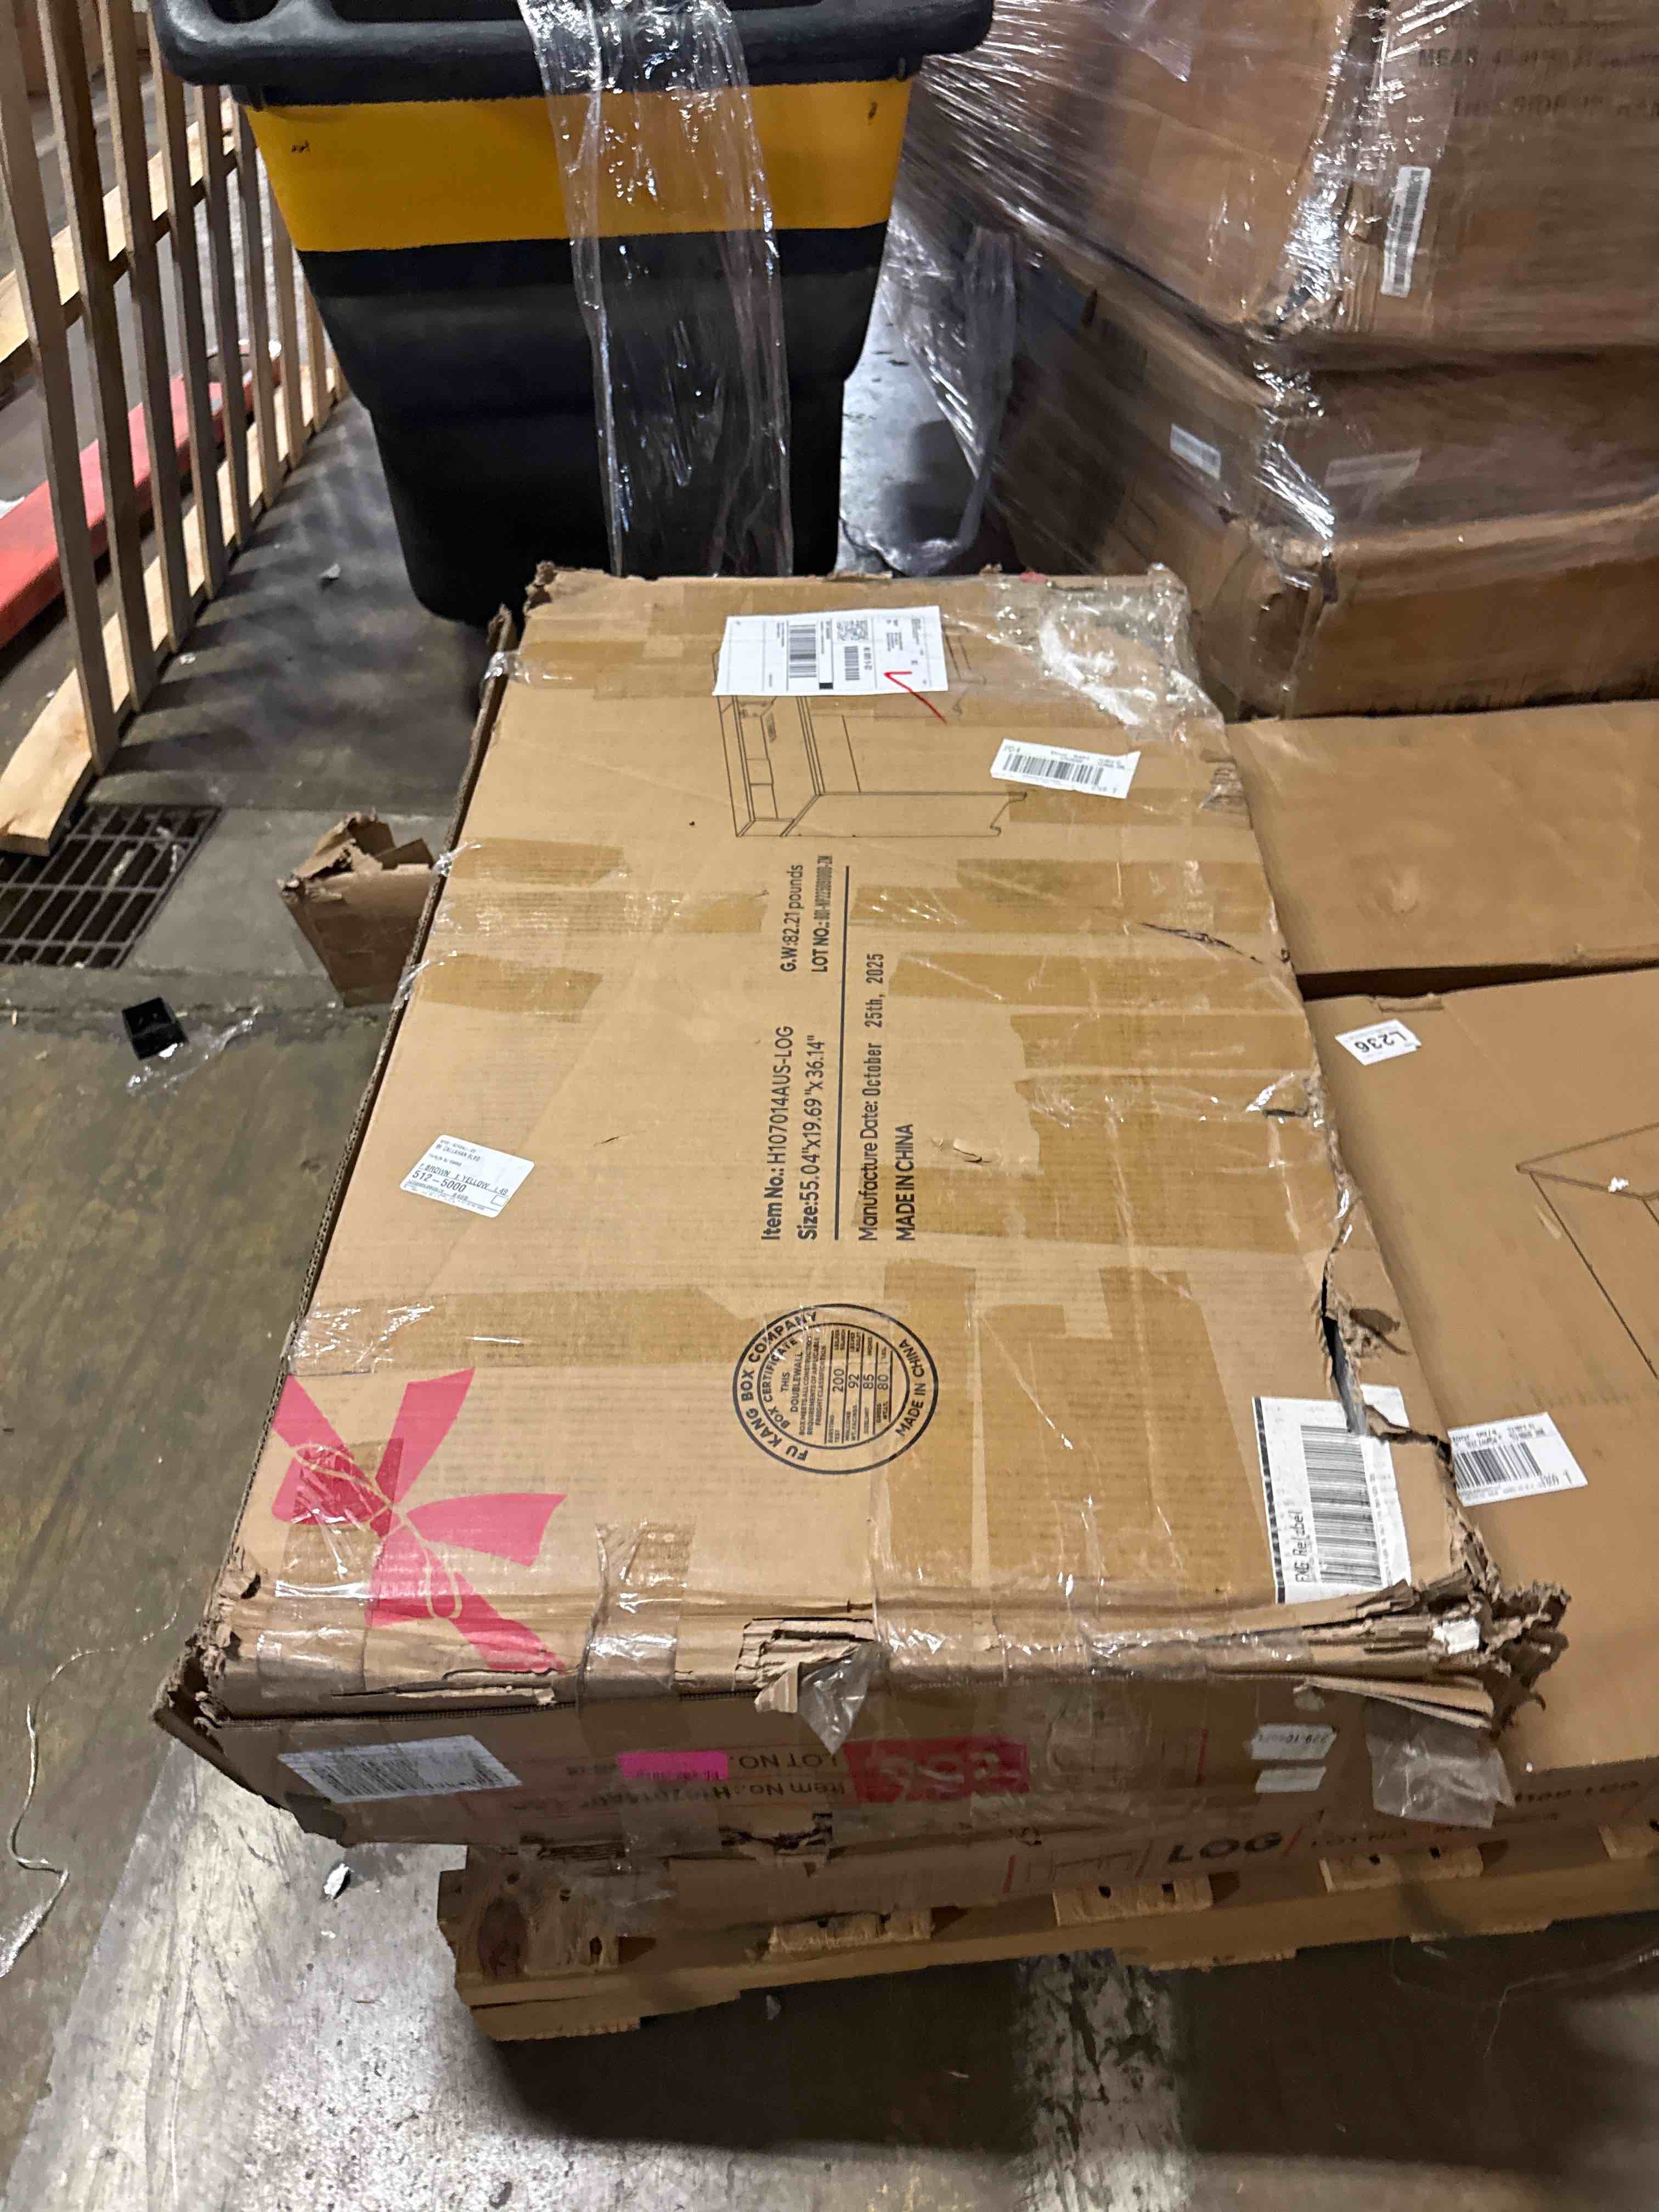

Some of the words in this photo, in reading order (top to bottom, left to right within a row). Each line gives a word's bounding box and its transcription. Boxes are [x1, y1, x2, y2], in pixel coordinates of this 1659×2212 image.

[786, 865, 805, 909] pounds
[780, 912, 800, 972] G.W:82.21
[812, 922, 830, 946] NO.:
[811, 949, 828, 973] LOT
[865, 952, 884, 984] 2025
[864, 994, 886, 1028] 25th,
[1354, 1030, 1407, 1053] L236
[861, 1042, 883, 1097] October
[766, 1025, 794, 1165] H107014AUS-LOG
[860, 1101, 878, 1139] Date:
[895, 1124, 915, 1172] CHINA
[764, 1167, 785, 1199] No.:
[859, 1143, 878, 1241] Manufacture
[895, 1175, 914, 1191] IN
[761, 1203, 783, 1241] Item
[895, 1193, 915, 1241] MADE
[748, 1311, 817, 1363] COMPANY
[802, 1335, 812, 1386] CONSTRUCTIO
[899, 1338, 925, 1378] CHINA
[740, 1369, 754, 1402] BOX
[781, 1372, 791, 1392] THIS
[832, 1368, 845, 1393] 200
[848, 1373, 860, 1389] 92
[862, 1373, 874, 1390] 85
[877, 1373, 888, 1391] 80
[918, 1382, 926, 1397] IN
[745, 1407, 783, 1448] KANG
[769, 1404, 791, 1429] BOX
[895, 1401, 924, 1437] MADE
[785, 1445, 809, 1462] FU
